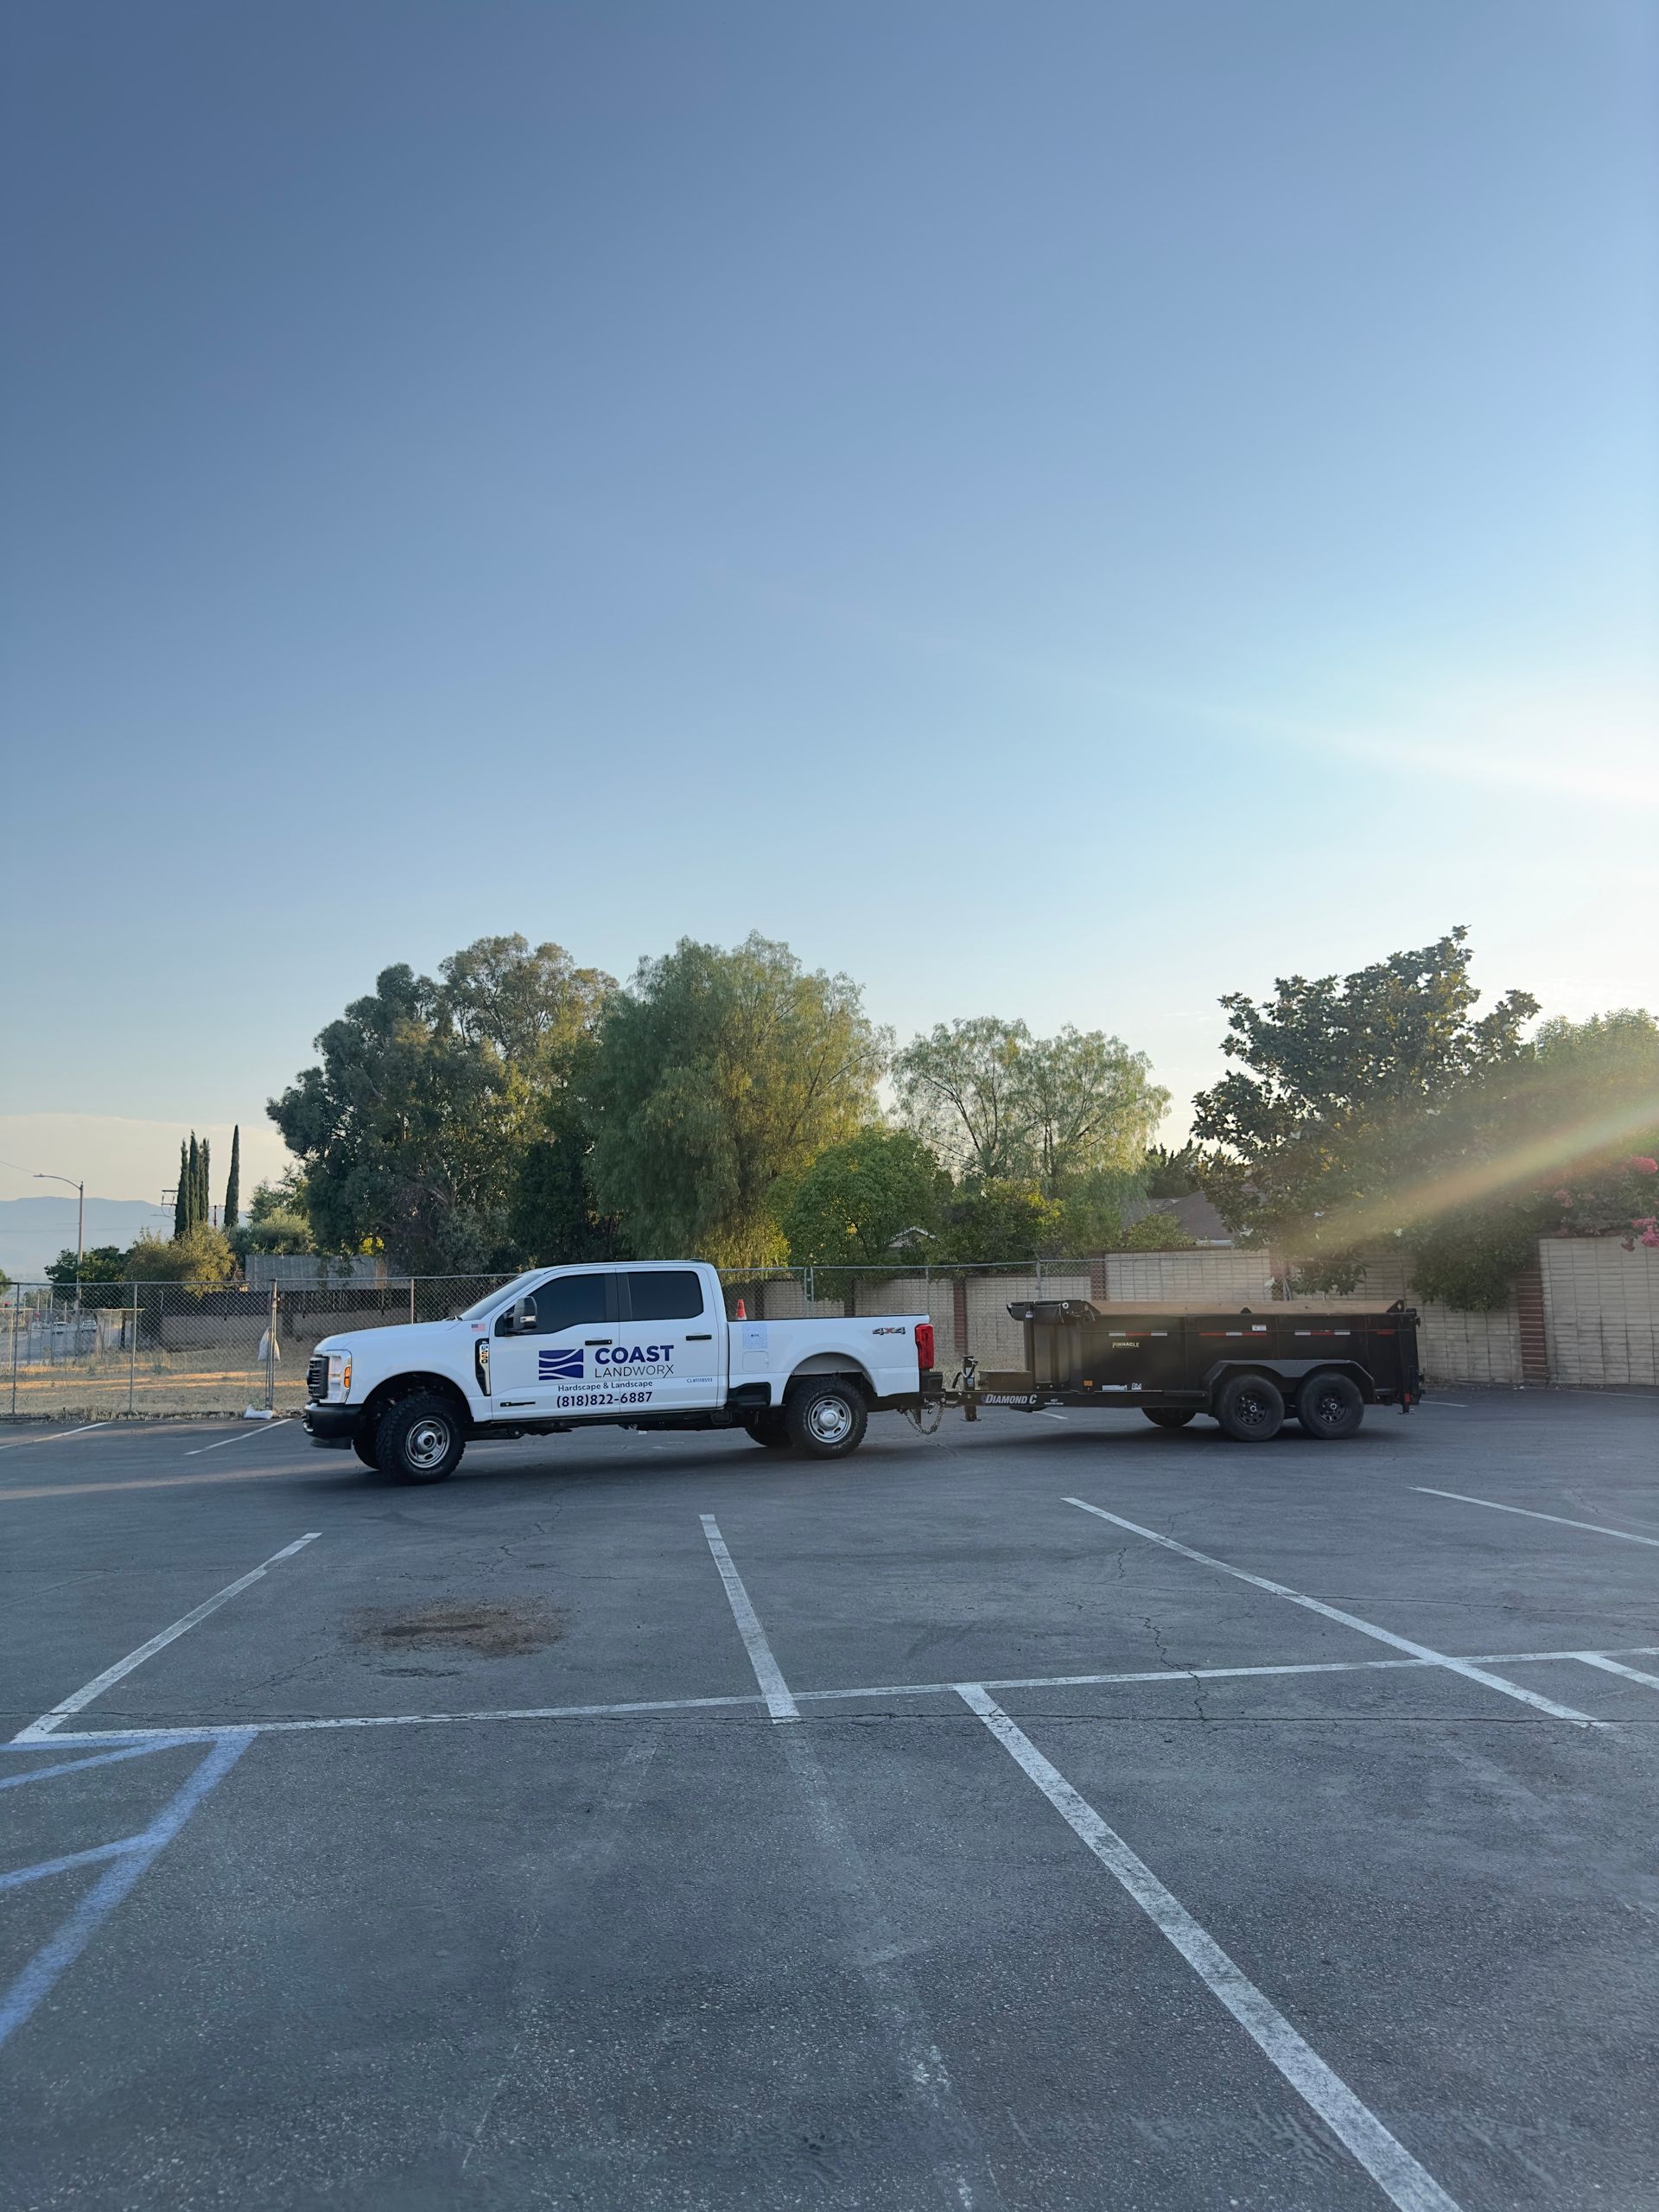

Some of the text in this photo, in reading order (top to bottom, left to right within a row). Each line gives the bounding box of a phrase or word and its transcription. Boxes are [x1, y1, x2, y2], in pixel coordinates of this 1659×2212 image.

[595, 1345, 674, 1364] COAST
[595, 1364, 674, 1378] LANDWORX
[556, 1391, 653, 1408] (818)822-6887
[985, 1394, 1028, 1403] DIAMOND
[1029, 1394, 1037, 1404] C
